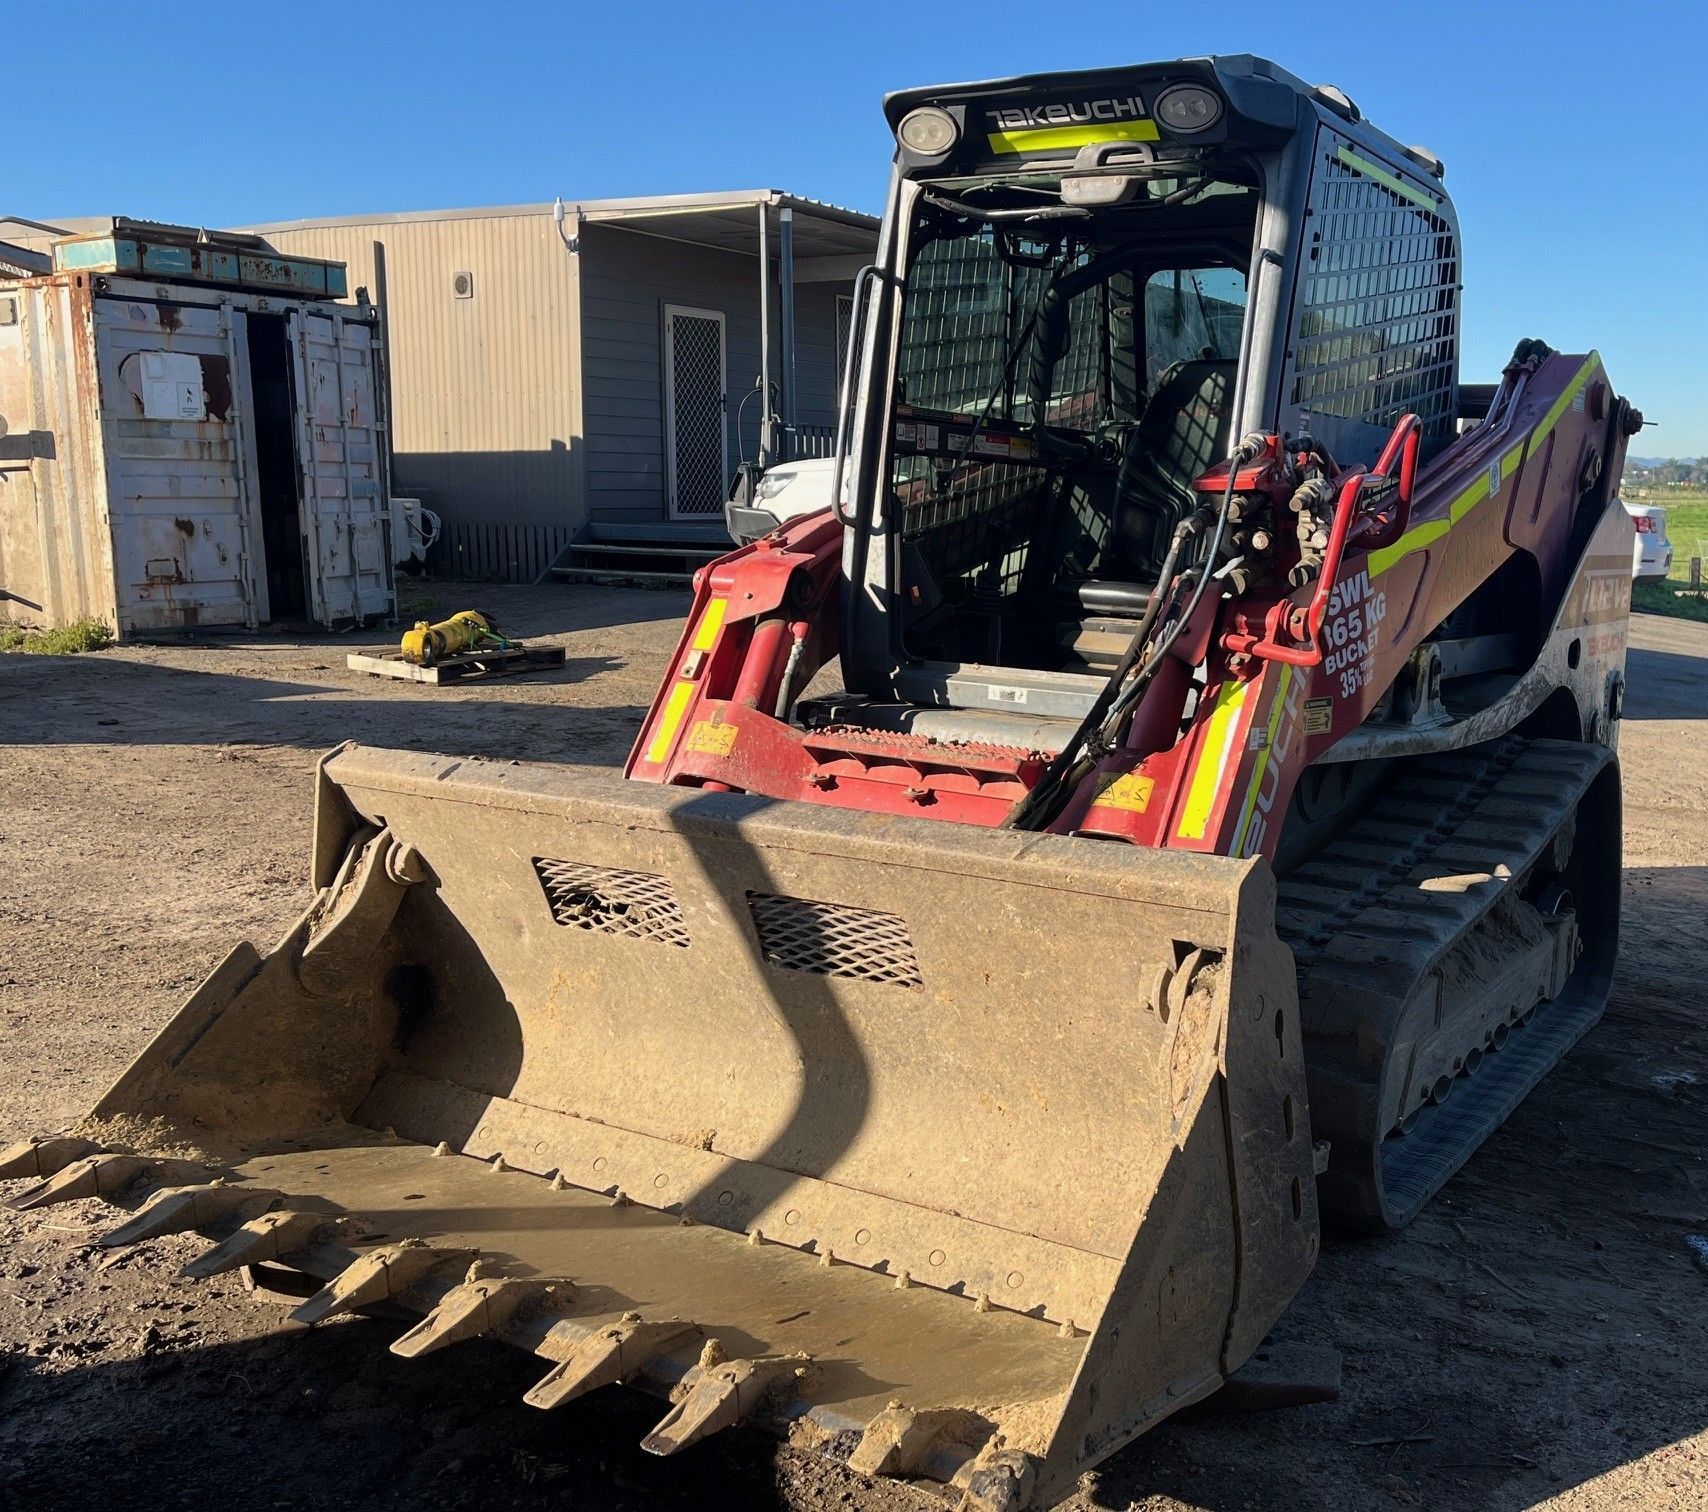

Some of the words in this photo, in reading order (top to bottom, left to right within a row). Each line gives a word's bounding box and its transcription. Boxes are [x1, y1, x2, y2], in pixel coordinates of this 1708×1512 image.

[1328, 569, 1375, 616] SWL
[1365, 591, 1386, 630] KG
[1324, 627, 1380, 675] BUCKET
